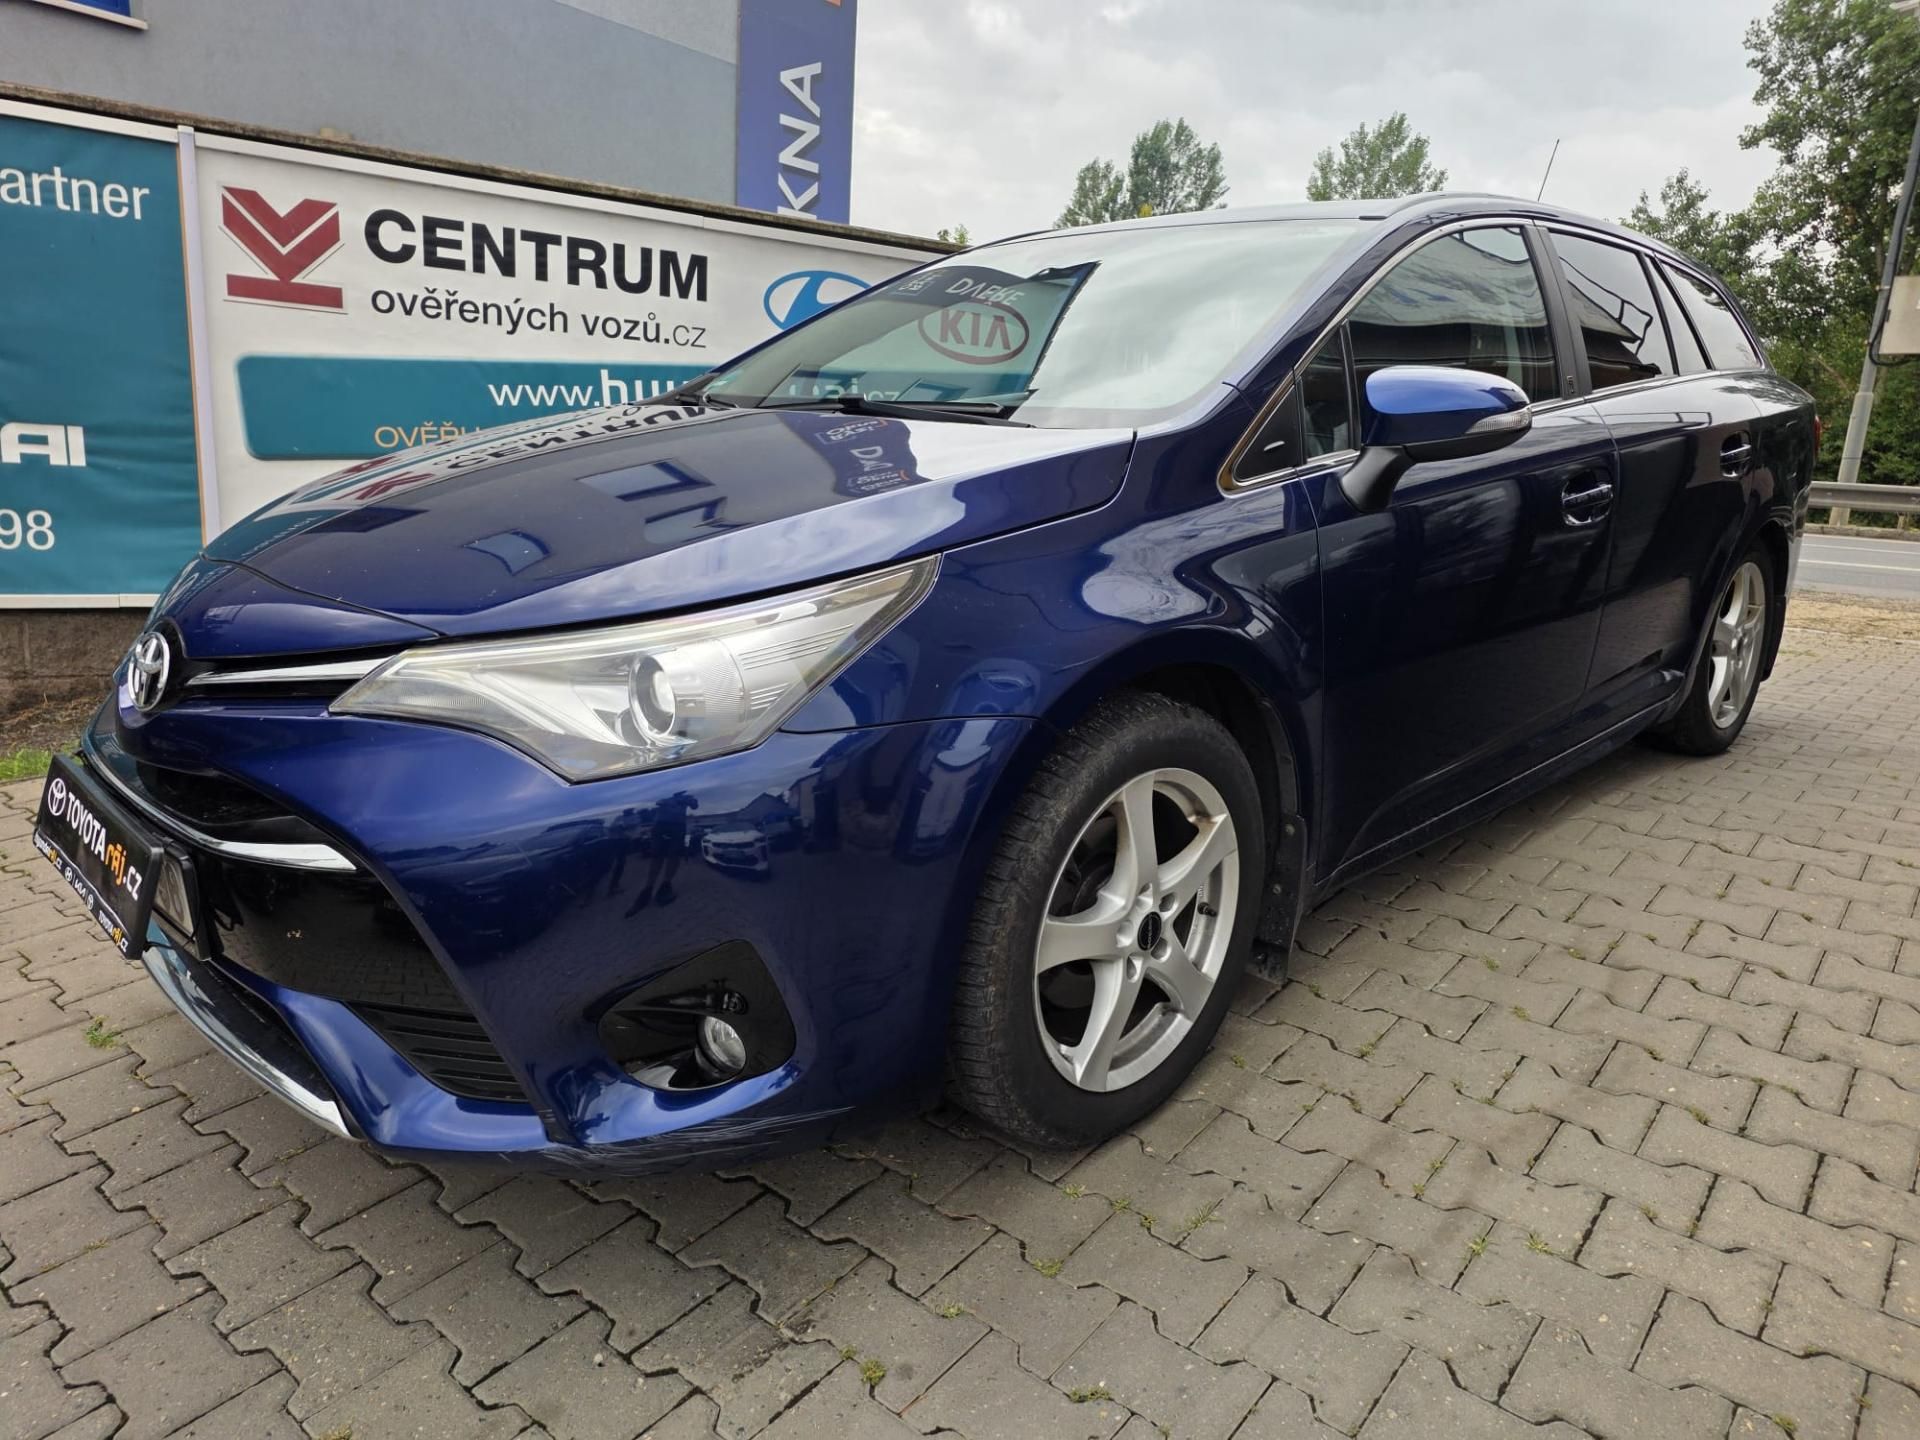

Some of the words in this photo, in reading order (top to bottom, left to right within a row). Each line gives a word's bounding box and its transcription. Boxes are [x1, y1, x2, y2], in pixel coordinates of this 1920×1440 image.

[0, 166, 150, 220] artner
[364, 208, 708, 302] CENTRUM
[371, 286, 568, 336] ověřených
[581, 312, 707, 348] vozů.cz
[939, 310, 1011, 350] KIA
[0, 422, 86, 467] AI
[0, 508, 55, 551] 98
